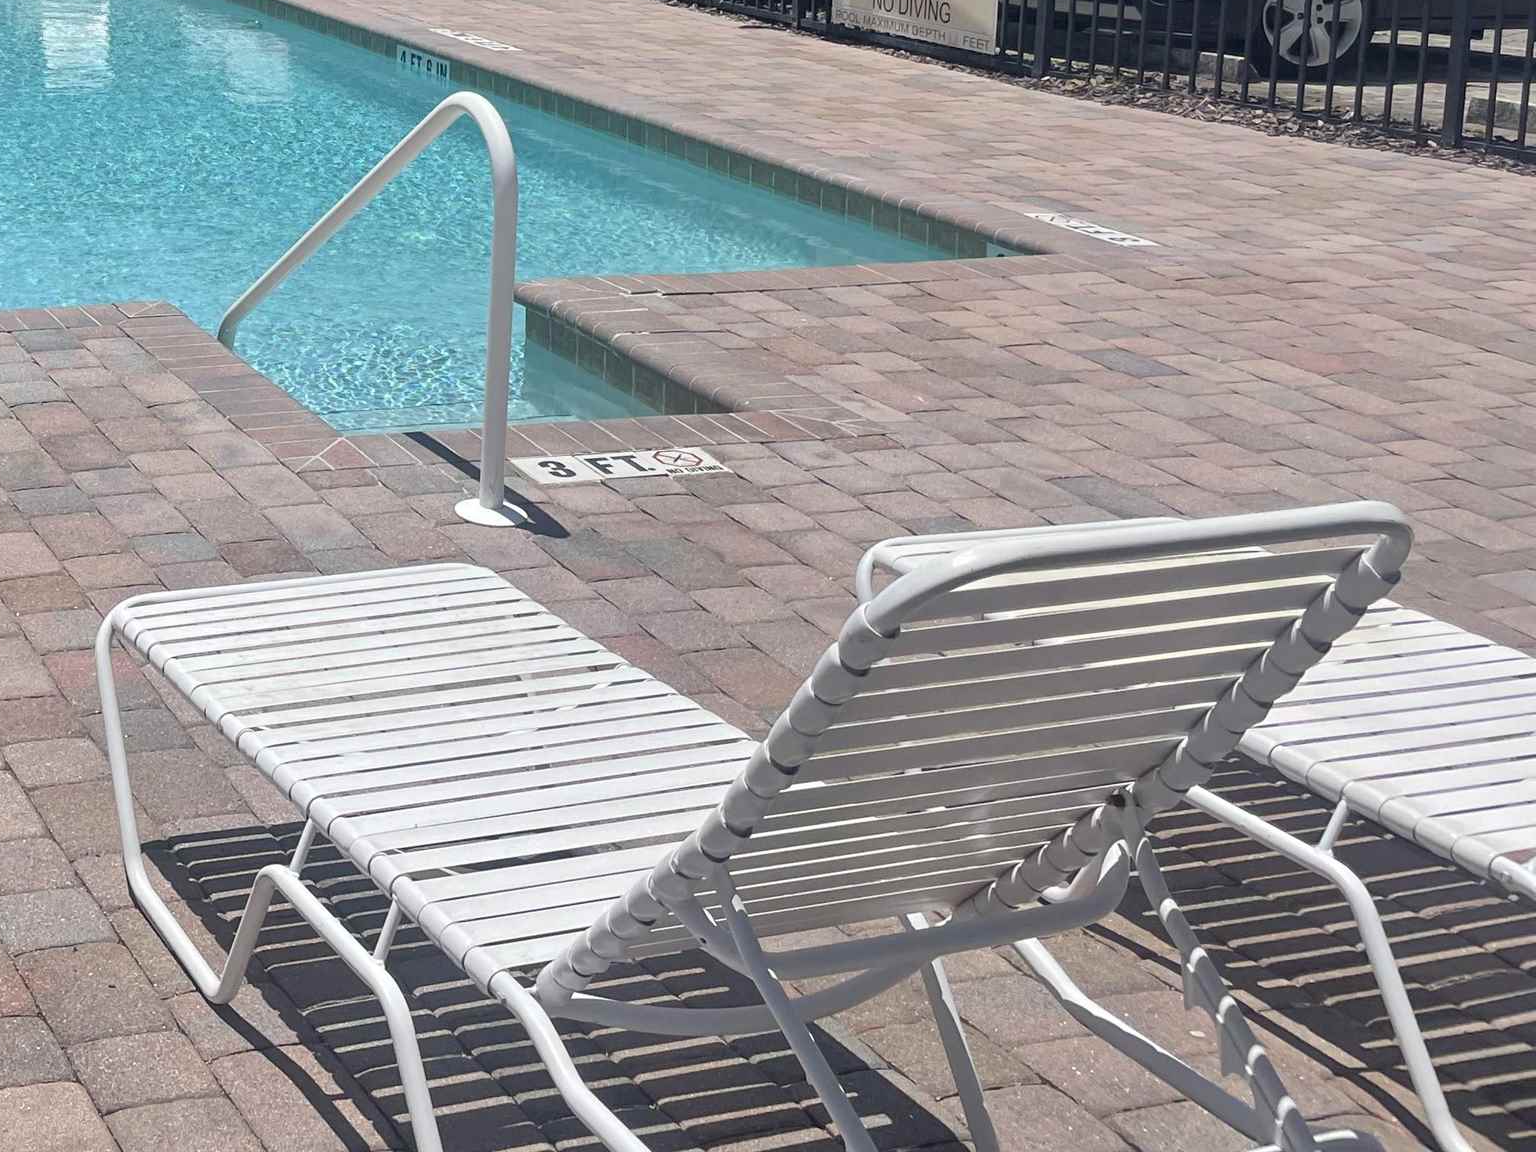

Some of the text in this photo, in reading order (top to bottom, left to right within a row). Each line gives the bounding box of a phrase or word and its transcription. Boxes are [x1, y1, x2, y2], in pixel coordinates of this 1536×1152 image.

[836, 9, 862, 24] POOL
[863, 14, 909, 33] MAXIMUM
[911, 24, 946, 41] DEPTH
[962, 35, 991, 50] FEET
[537, 454, 657, 478] 3 FT.
